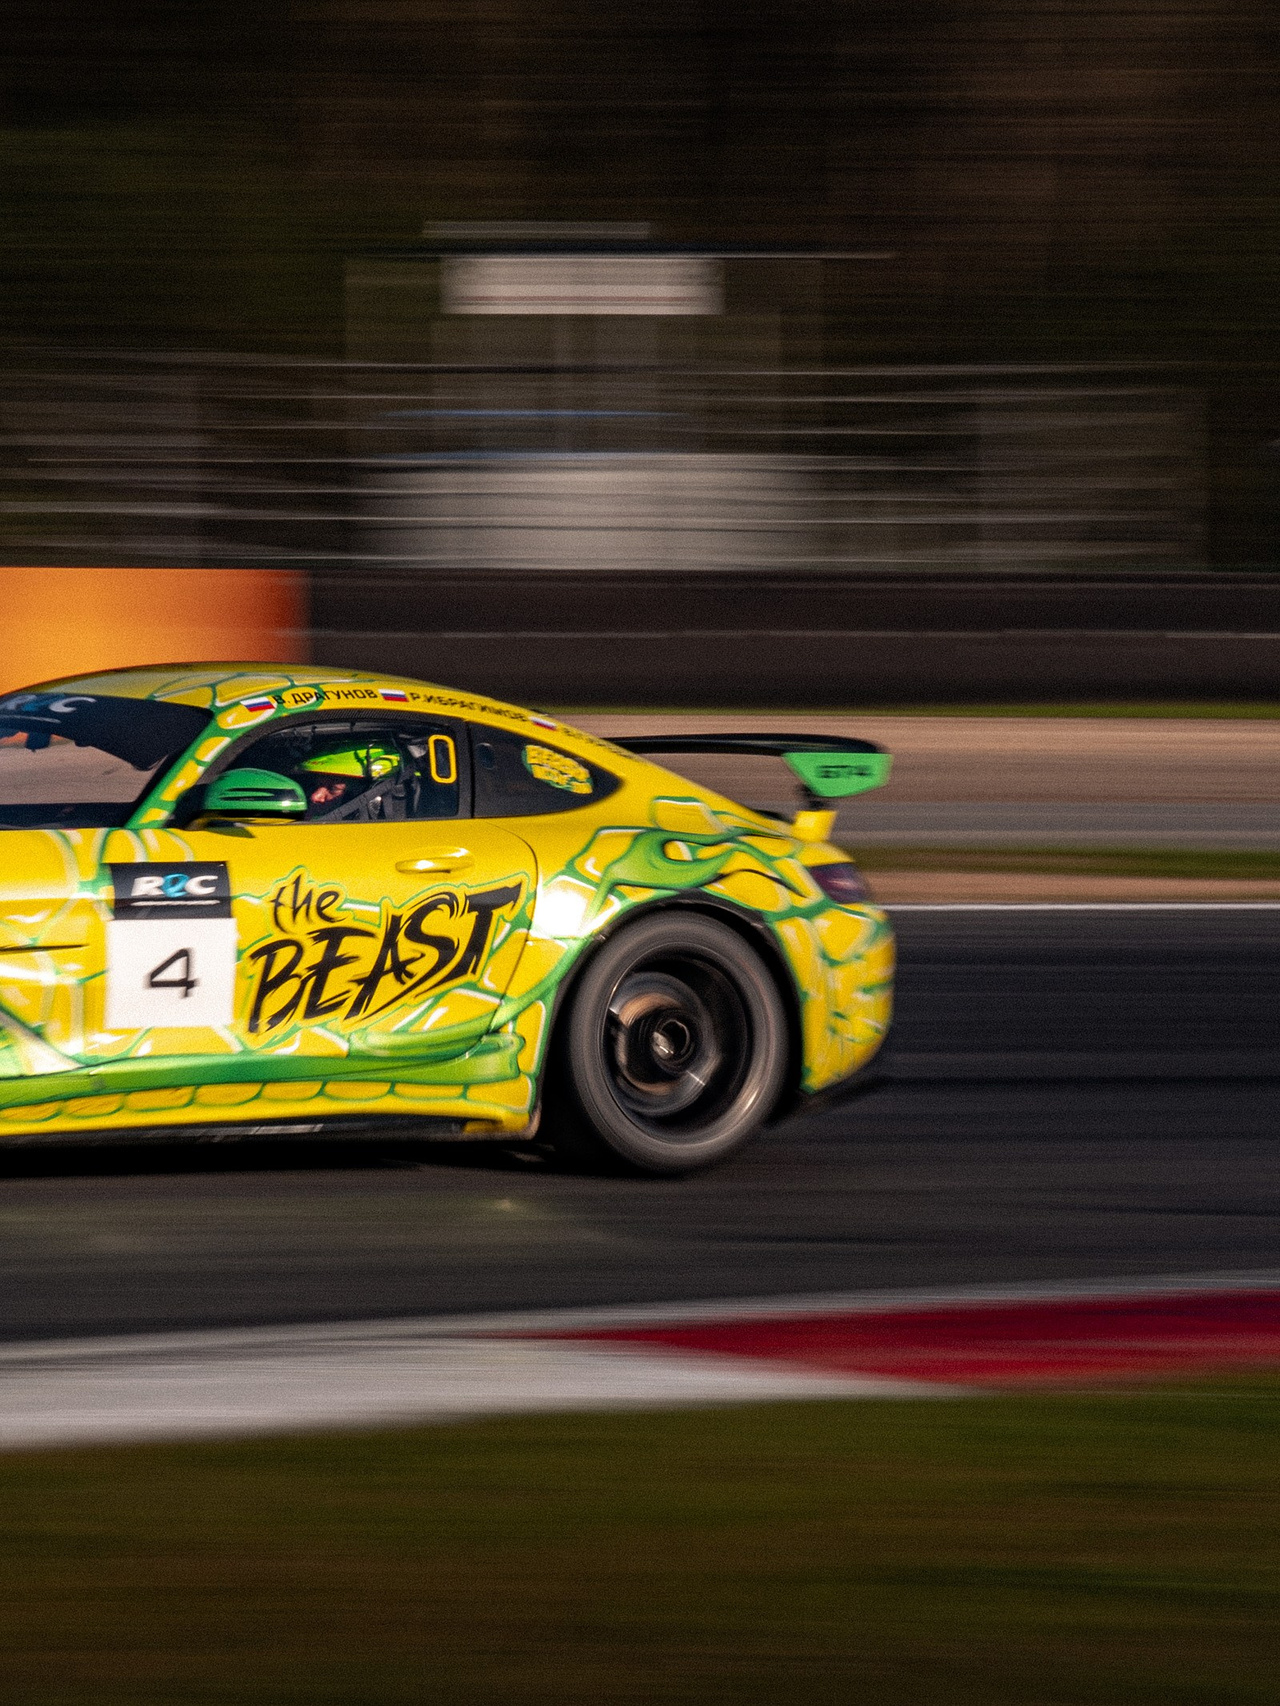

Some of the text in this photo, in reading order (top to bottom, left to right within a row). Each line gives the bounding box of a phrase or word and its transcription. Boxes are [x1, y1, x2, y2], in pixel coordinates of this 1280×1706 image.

[270, 874, 349, 933] the
[144, 947, 199, 998] 4
[247, 881, 522, 1034] BEAST
